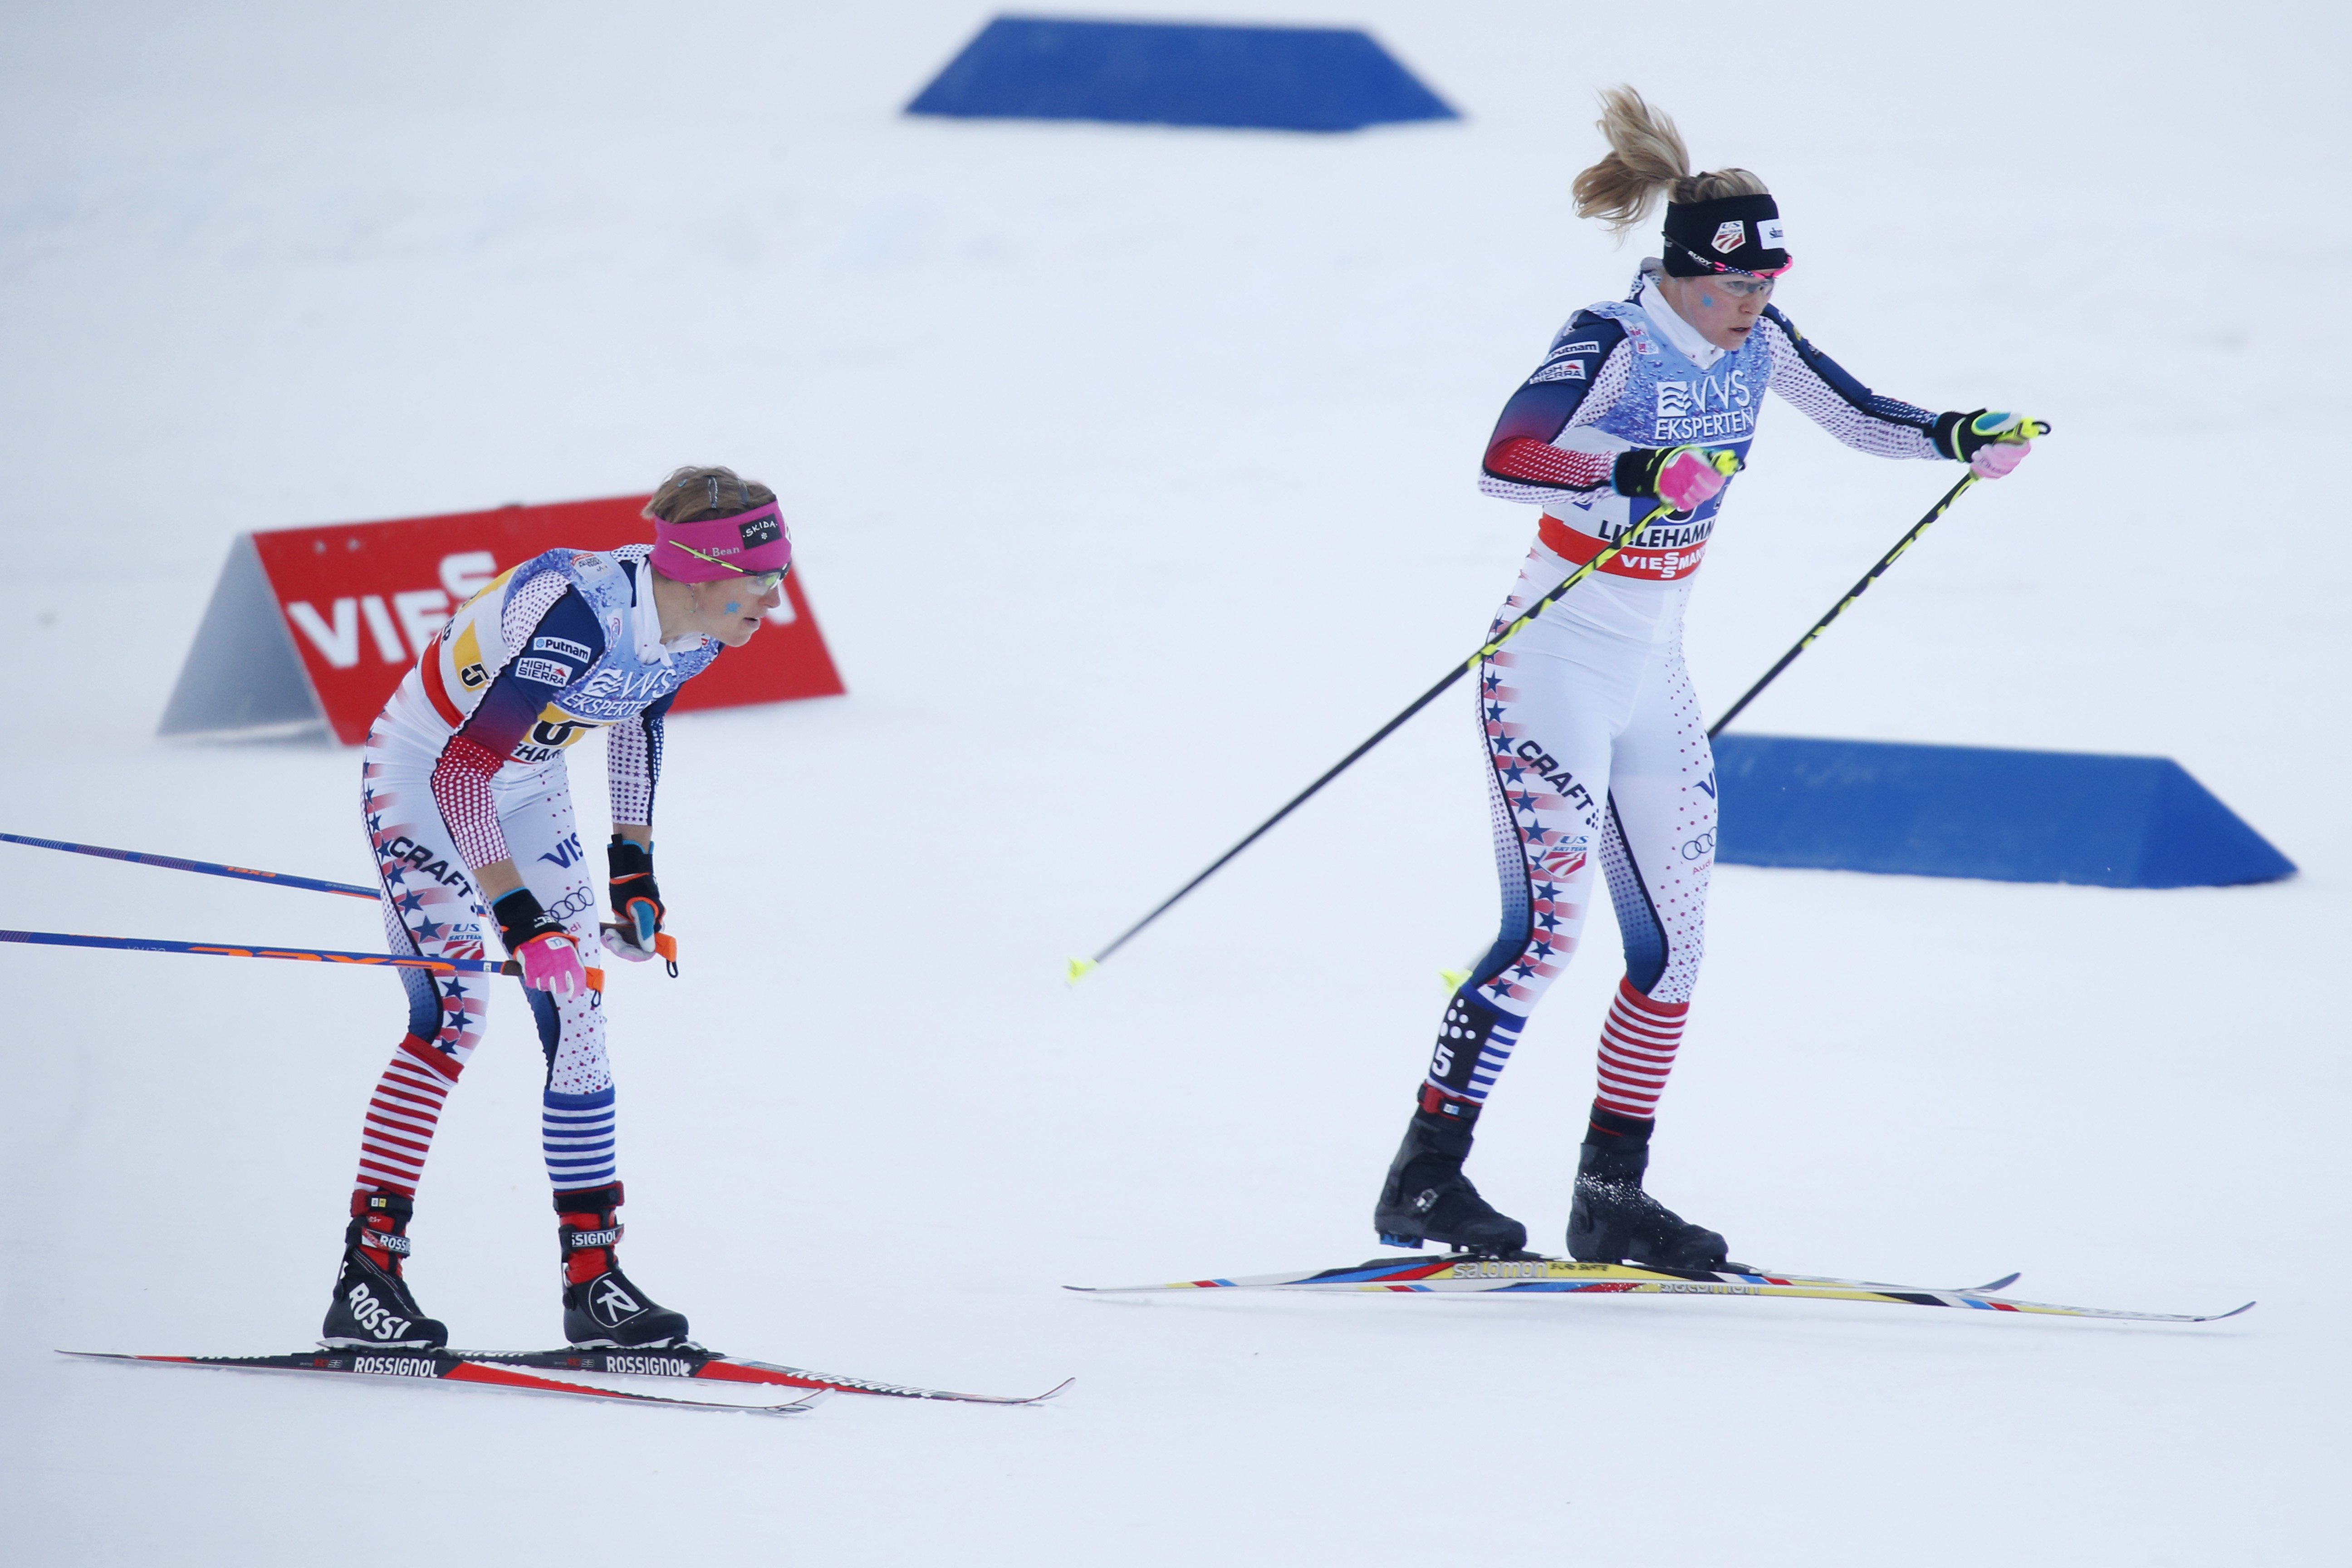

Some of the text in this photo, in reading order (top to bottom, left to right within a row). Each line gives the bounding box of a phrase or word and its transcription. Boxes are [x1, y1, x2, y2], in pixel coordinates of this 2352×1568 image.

[1687, 250, 1712, 266] RUDY
[1551, 343, 1597, 358] Putnam
[1692, 370, 1750, 414] VVS
[1655, 406, 1754, 440] EKSPERTEN
[545, 639, 588, 660] Putnam
[518, 666, 564, 685] SIERRA
[520, 659, 553, 672] HIGH
[620, 668, 677, 700] VVS
[1516, 740, 1595, 811] CRAFT
[1560, 835, 1589, 844] US
[389, 836, 474, 898] CRAFT
[453, 923, 480, 932] US
[1431, 1042, 1455, 1078] 5
[1453, 1262, 1548, 1279] salomon
[349, 1283, 412, 1340] ROSSI
[353, 1357, 439, 1378] ROSSIGNOL
[606, 1356, 690, 1377] ROSSIGNOL
